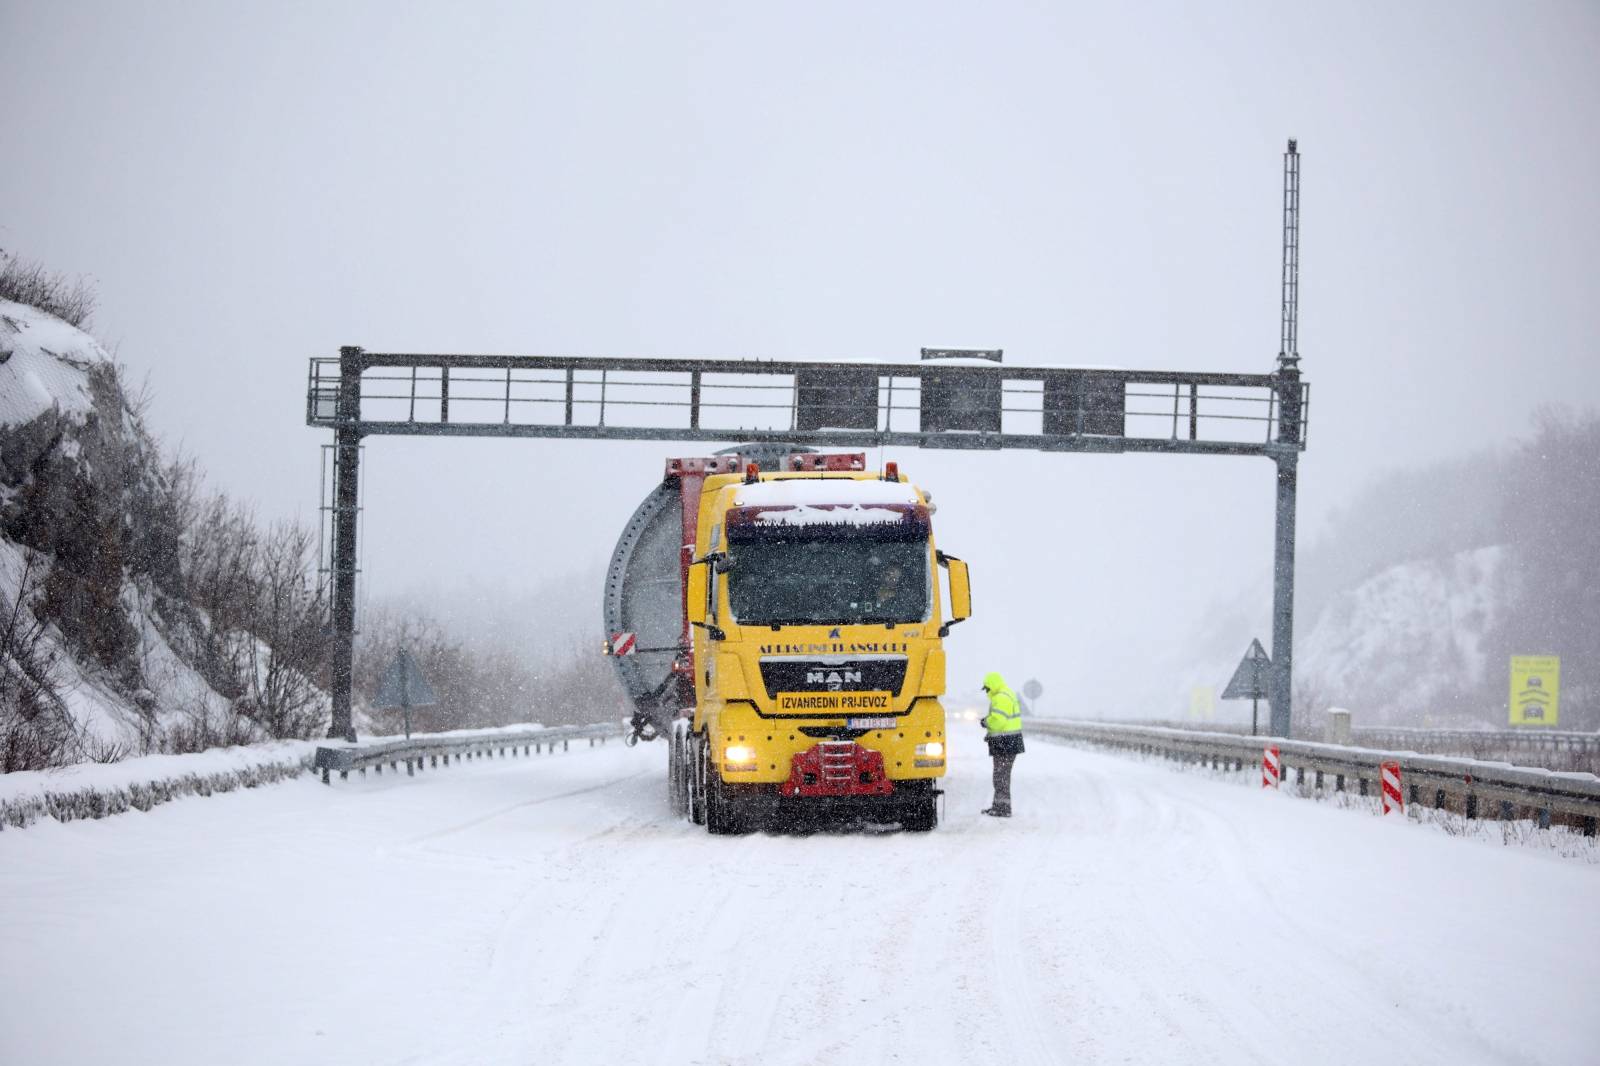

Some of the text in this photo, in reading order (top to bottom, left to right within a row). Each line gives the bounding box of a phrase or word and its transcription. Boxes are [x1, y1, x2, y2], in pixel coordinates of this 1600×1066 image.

[806, 671, 862, 683] MAN
[781, 695, 888, 709] IZVANREDNI PRIJEVOZ
